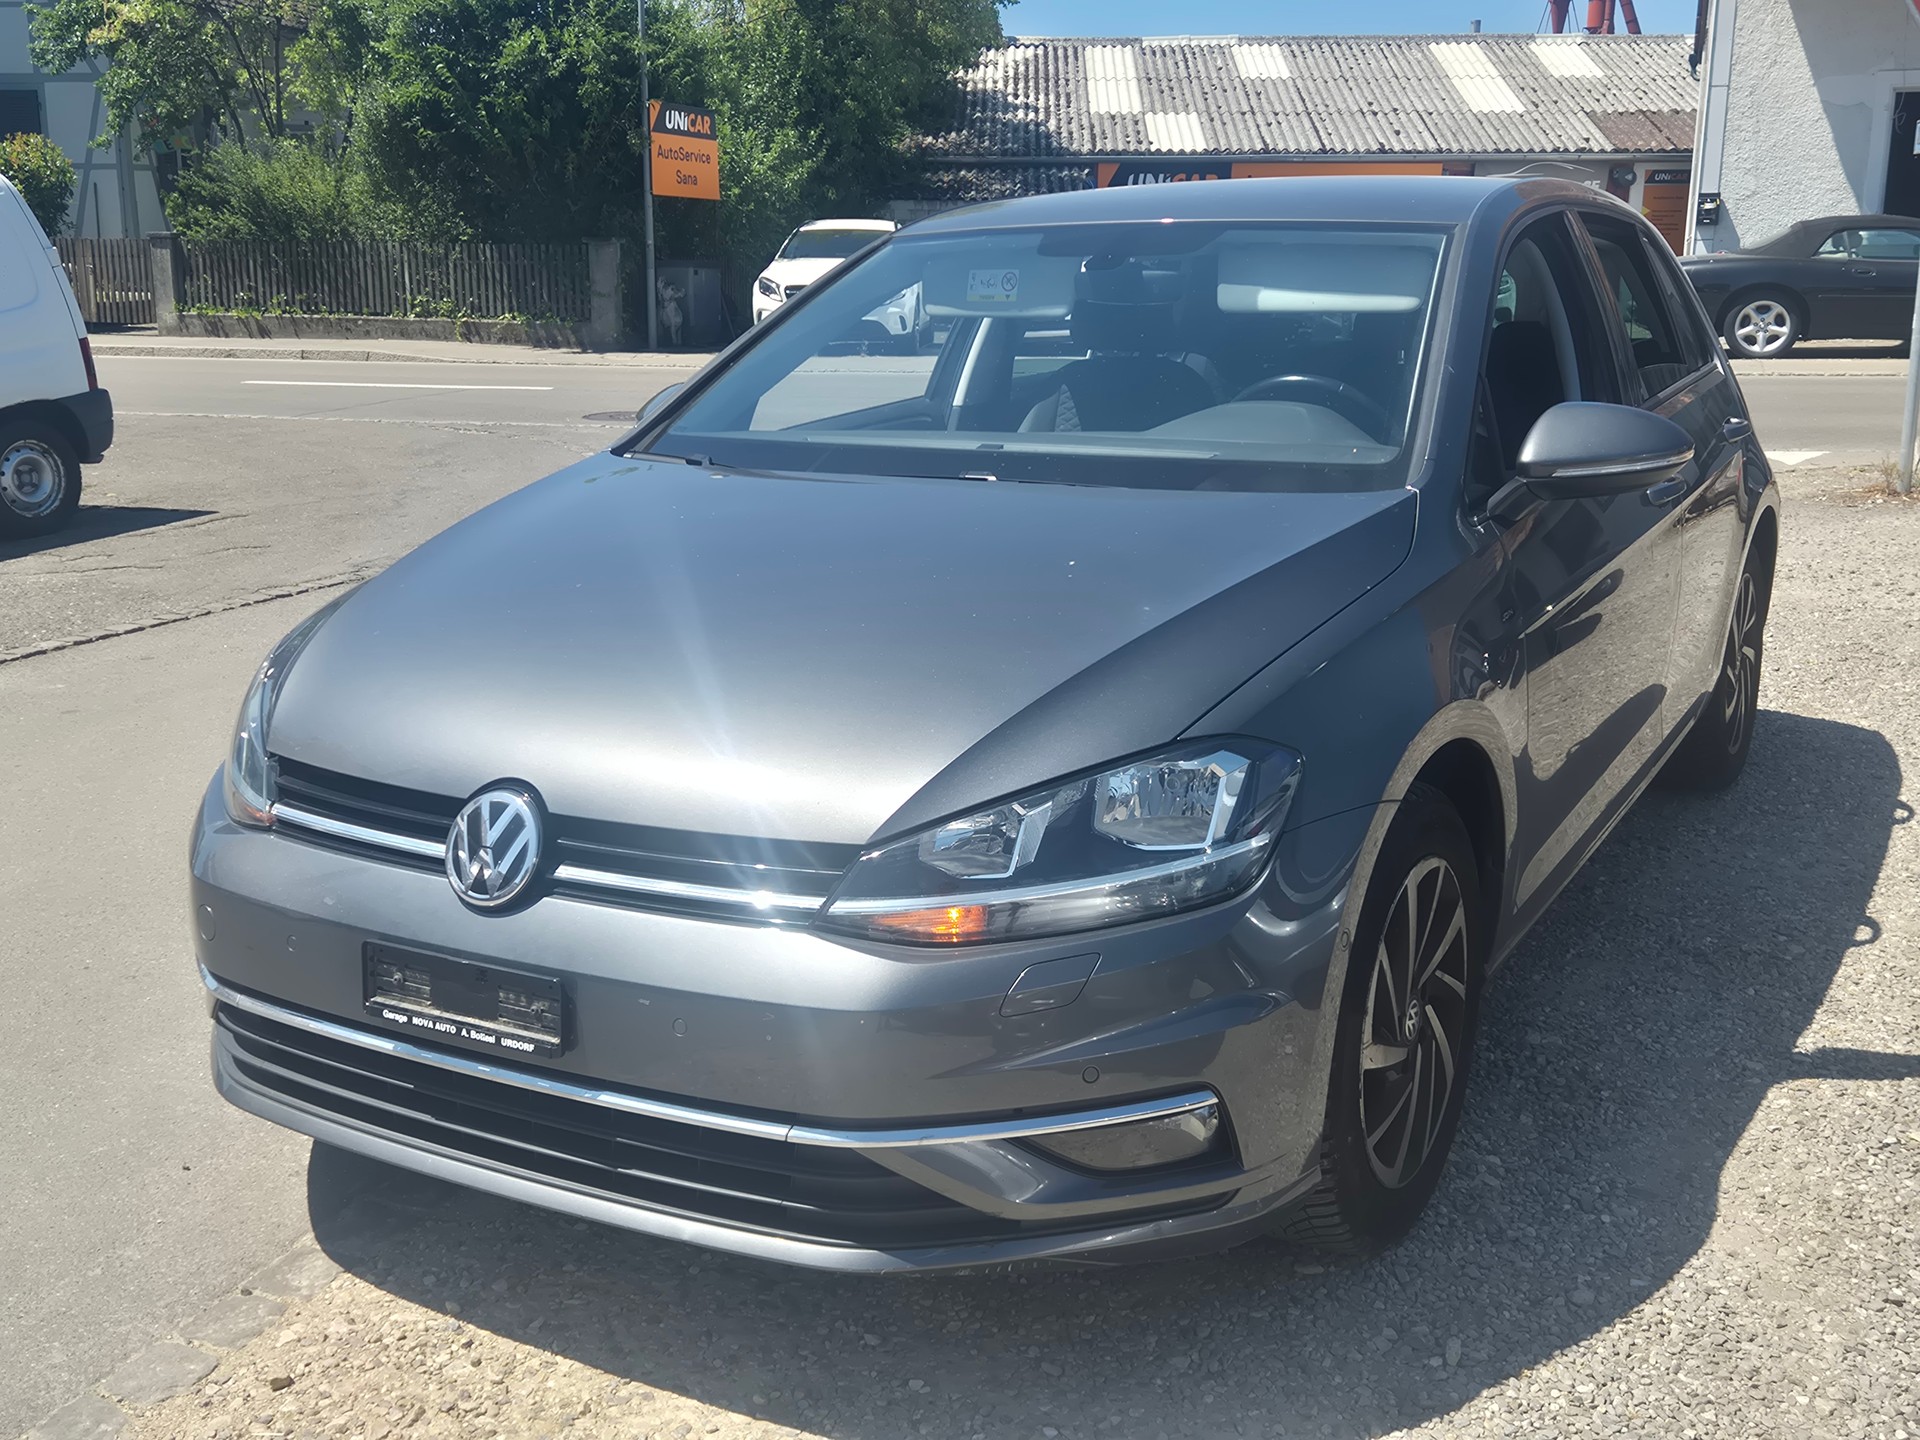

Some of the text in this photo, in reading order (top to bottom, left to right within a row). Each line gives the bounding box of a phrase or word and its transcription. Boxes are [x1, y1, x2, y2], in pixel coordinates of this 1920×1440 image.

[657, 144, 711, 164] AutoService
[675, 169, 698, 185] Sana
[382, 1009, 408, 1024] Garage
[412, 1016, 434, 1029] NOVA
[434, 1021, 457, 1034] AUTO
[461, 1027, 470, 1038] A.
[500, 1037, 535, 1053] URDORF
